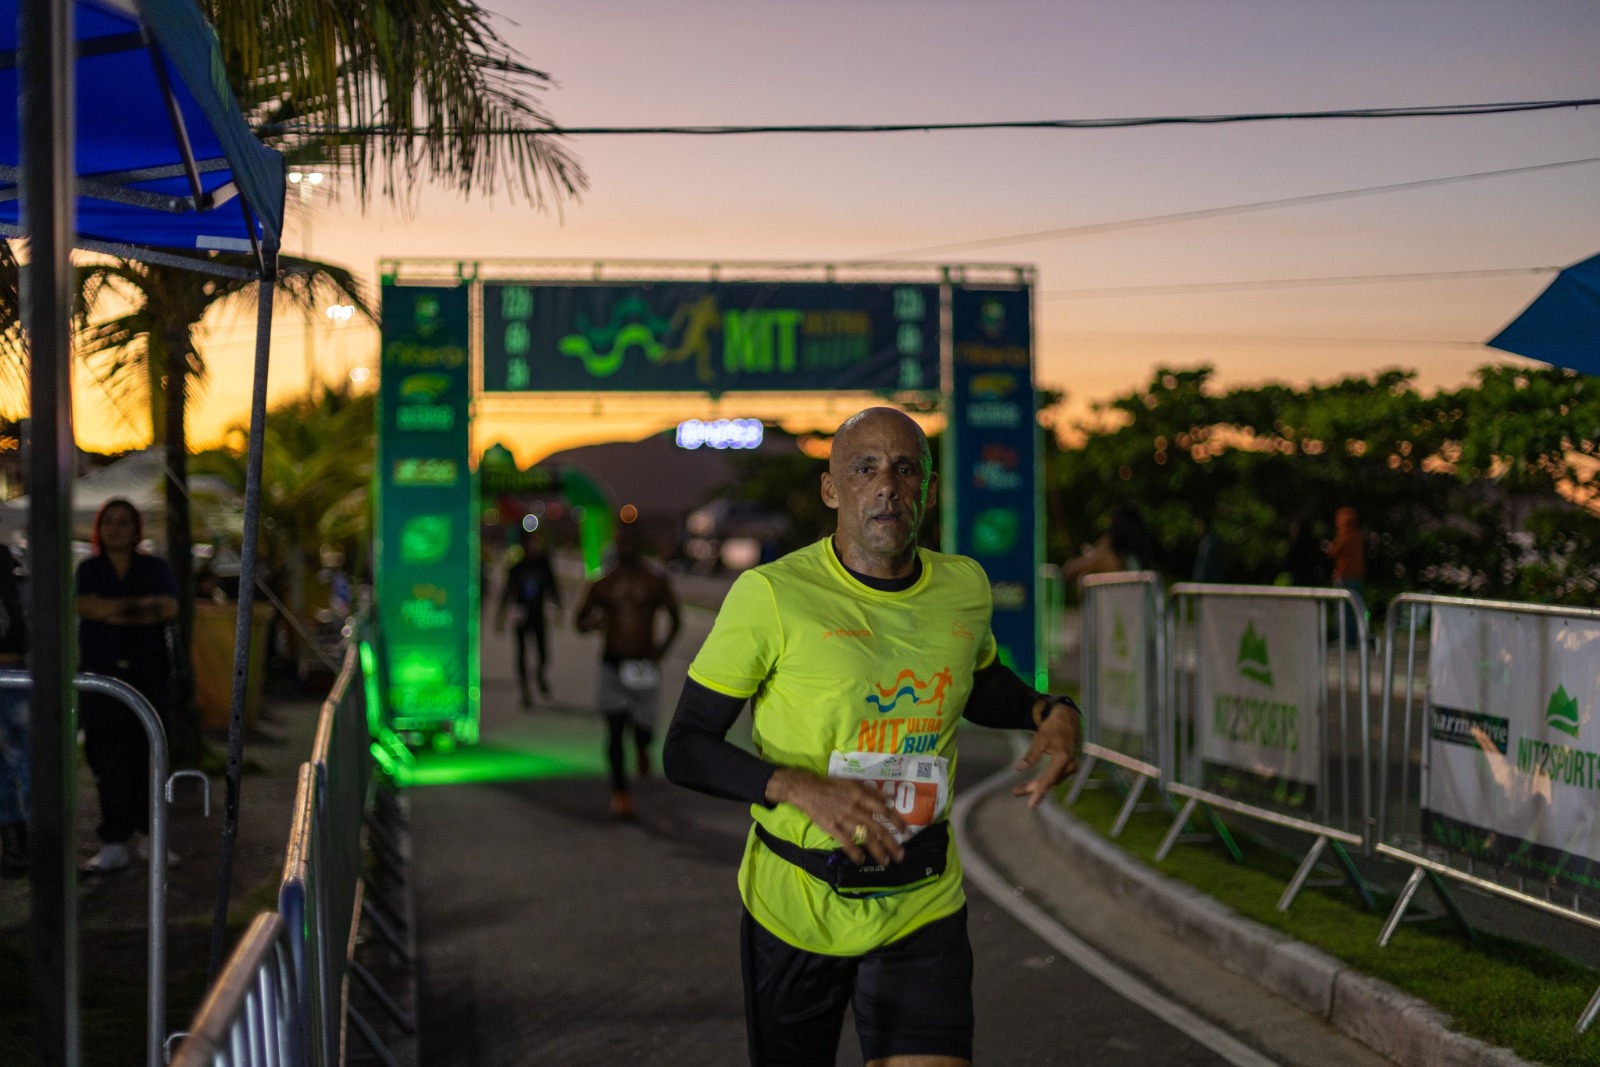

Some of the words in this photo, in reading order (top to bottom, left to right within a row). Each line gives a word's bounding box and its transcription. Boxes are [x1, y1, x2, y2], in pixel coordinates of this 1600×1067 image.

[724, 308, 803, 373] NIT
[858, 718, 905, 754] NIT
[906, 718, 943, 732] ULTRA
[903, 733, 940, 754] RUN
[863, 780, 916, 815] 40
